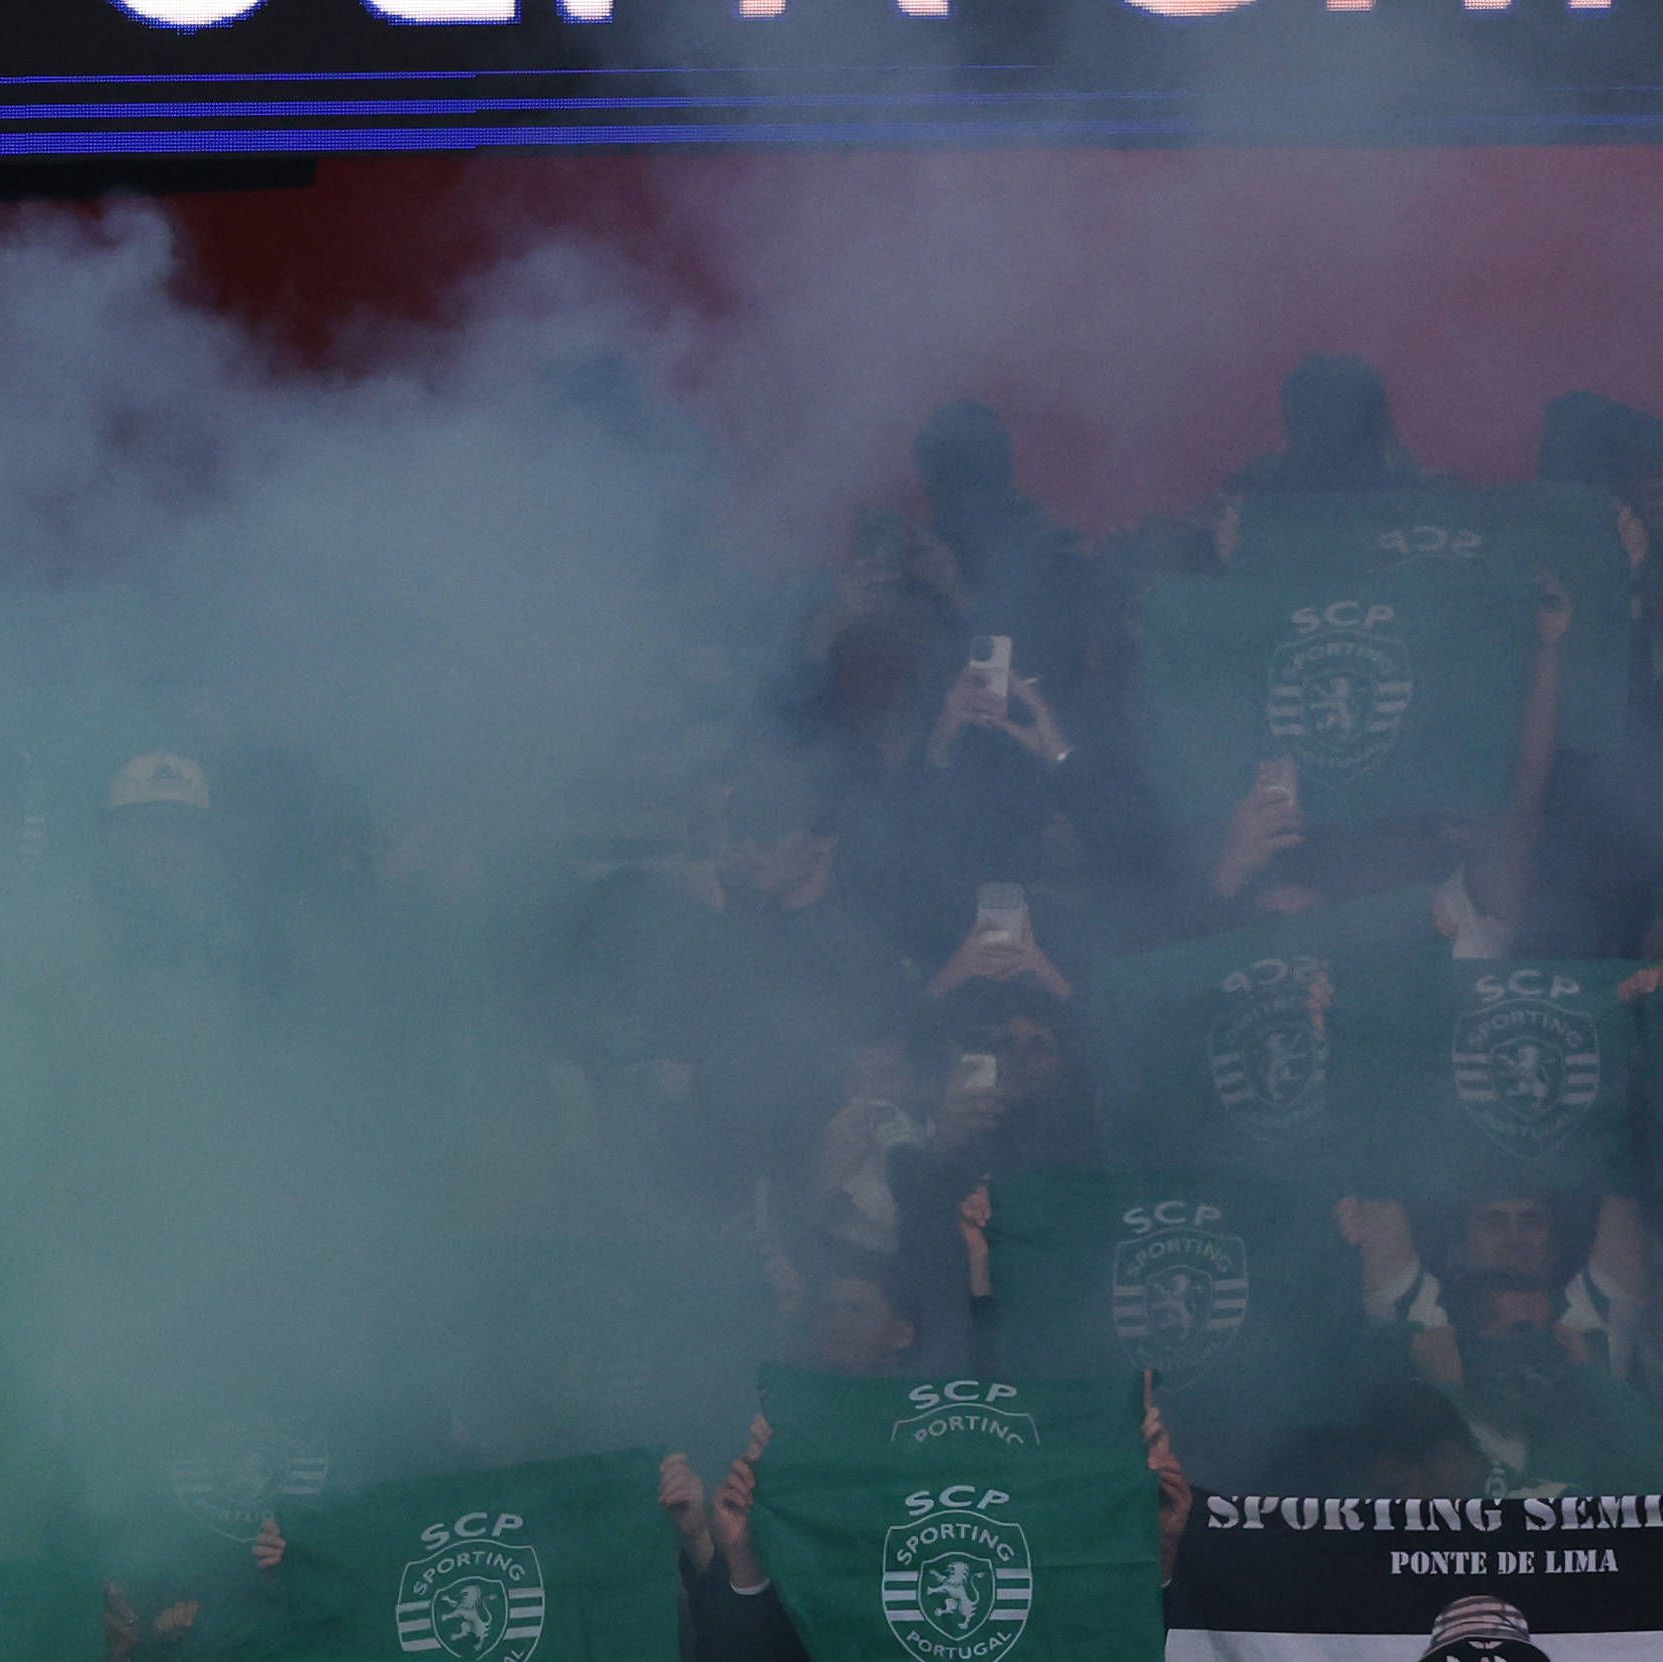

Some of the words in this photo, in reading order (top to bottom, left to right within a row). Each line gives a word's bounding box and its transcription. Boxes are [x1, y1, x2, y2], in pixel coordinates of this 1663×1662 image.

[1291, 601, 1395, 633] SCP
[1475, 969, 1580, 1002] SCP
[1475, 1009, 1582, 1047] SPORTING
[1122, 1201, 1222, 1234] SCP
[1124, 1234, 1233, 1274] SPORTING
[908, 1379, 1018, 1411] SCP
[904, 1484, 1011, 1517] SCP
[1206, 1495, 1504, 1532] SPORTING
[422, 1511, 524, 1550] SCP
[895, 1522, 1015, 1566] SPORTING
[412, 1550, 526, 1597] SPORTING
[1389, 1549, 1488, 1576] PONTE
[1497, 1550, 1537, 1576] DE
[1545, 1548, 1620, 1575] LIMA
[906, 1626, 1013, 1661] PORTUGAL
